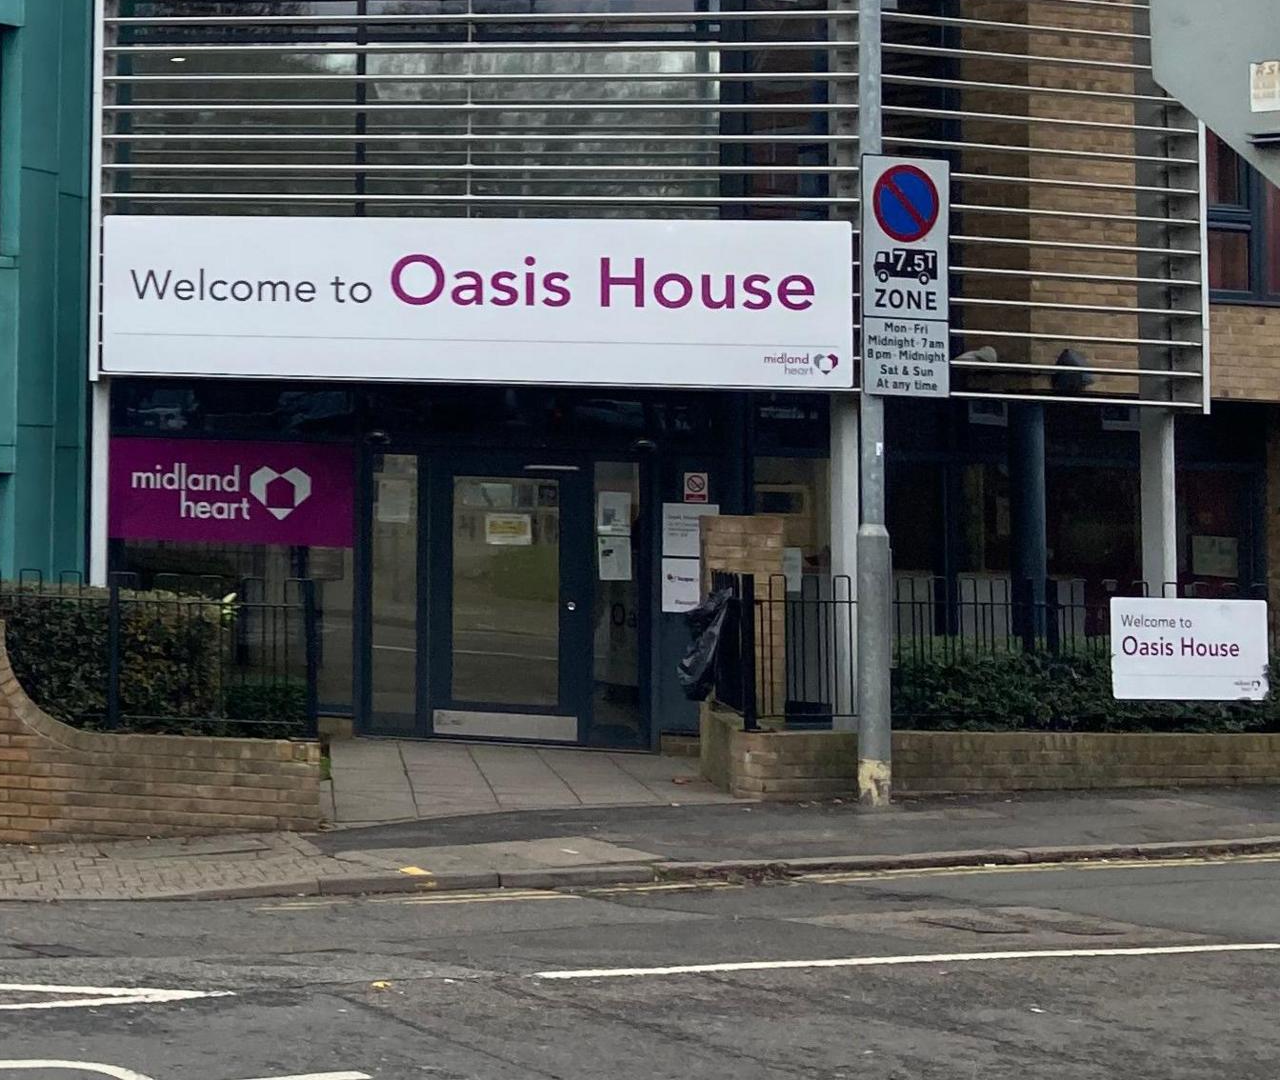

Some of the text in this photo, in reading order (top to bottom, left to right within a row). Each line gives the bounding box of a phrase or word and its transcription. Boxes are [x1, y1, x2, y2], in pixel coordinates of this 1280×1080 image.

[893, 250, 936, 271] 7.5T
[129, 253, 816, 311] Welcome to Oasis House
[874, 288, 937, 311] ZONE
[763, 353, 810, 365] midland
[784, 365, 814, 376] heart
[880, 363, 934, 377] Sat & Sun
[876, 378, 938, 392] At any time
[131, 462, 241, 492] midland
[180, 491, 251, 520] heart
[1120, 614, 1193, 628] Welcome to
[1122, 635, 1240, 657] Oasis House
